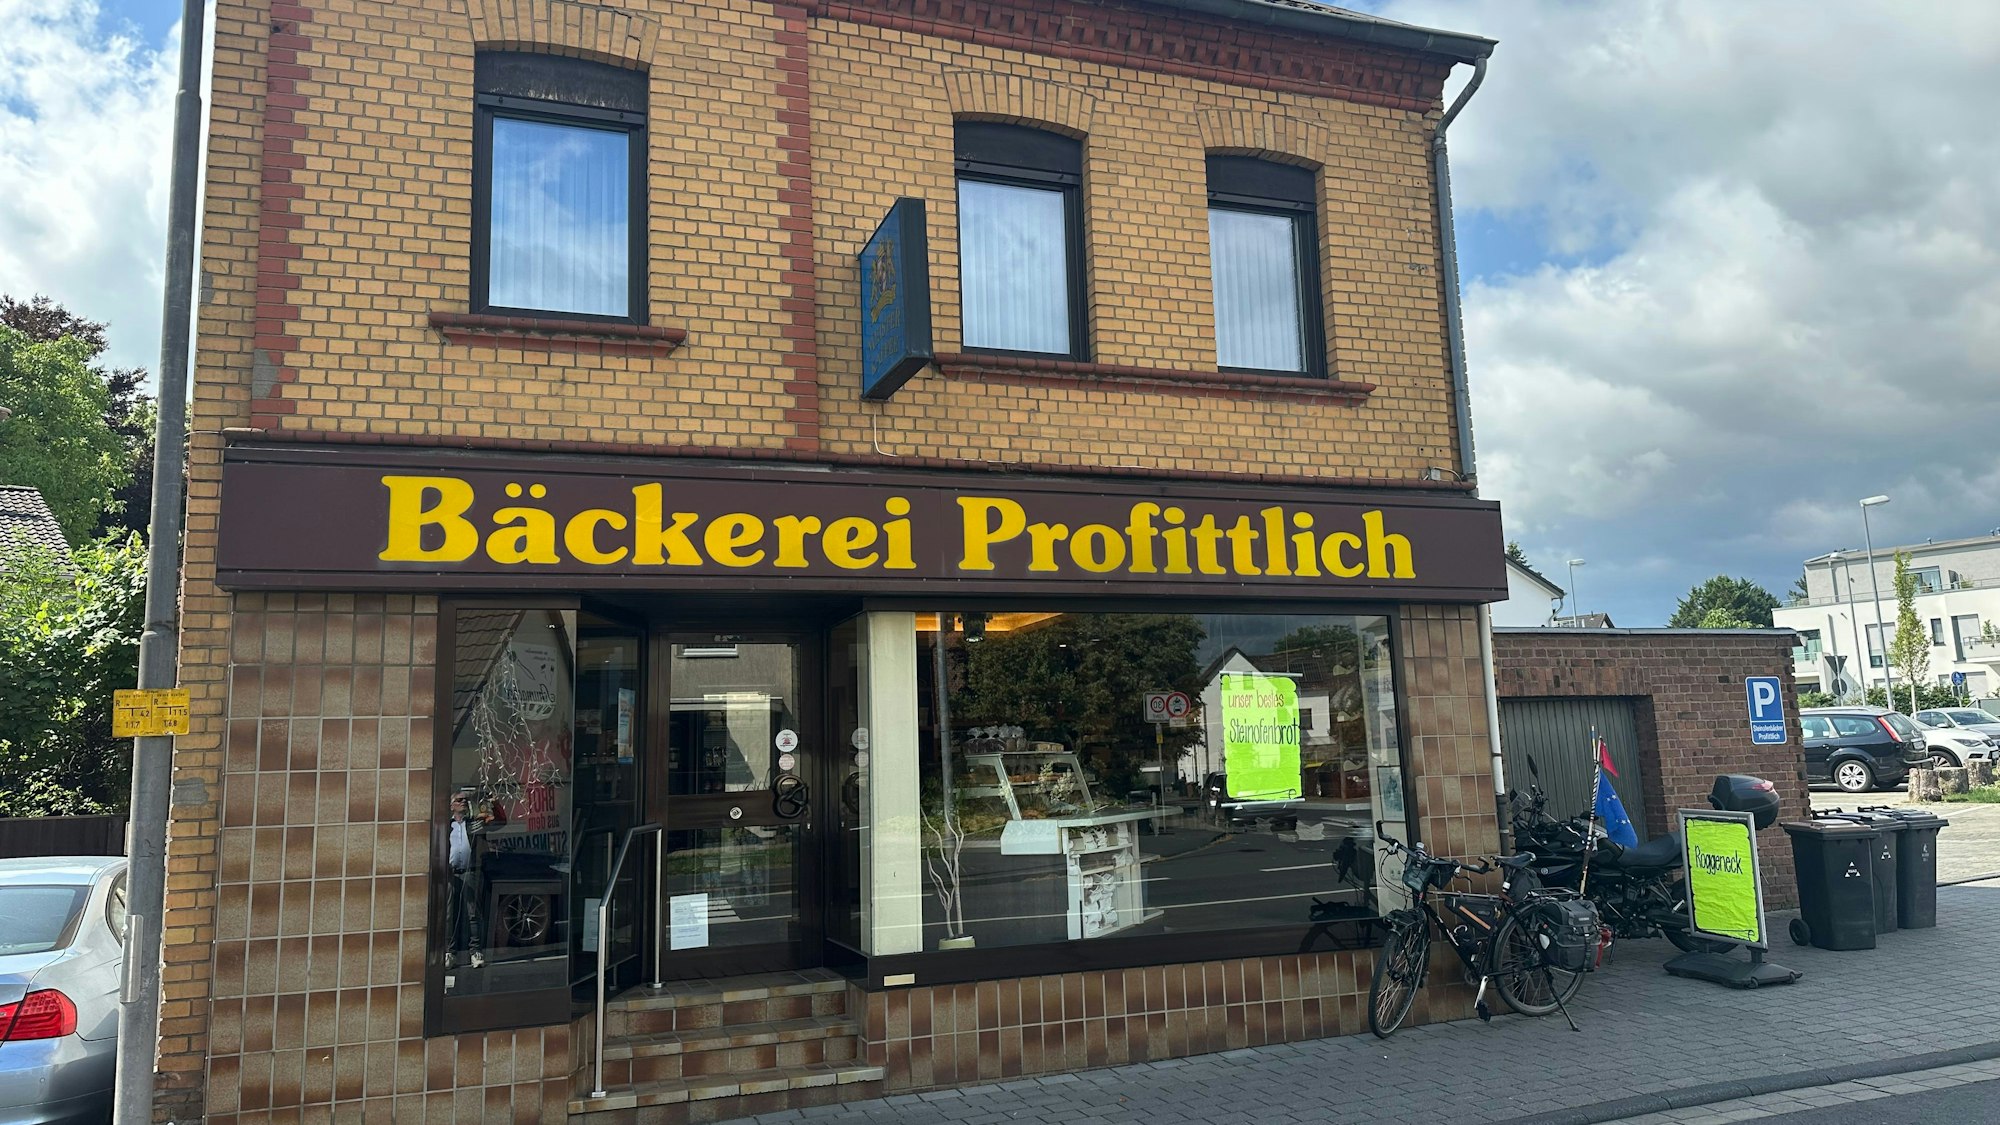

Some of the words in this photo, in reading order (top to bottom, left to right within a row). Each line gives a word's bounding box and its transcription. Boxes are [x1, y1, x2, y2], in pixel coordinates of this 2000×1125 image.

[378, 475, 917, 570] Bäckerei
[956, 496, 1416, 580] Profittlich
[153, 698, 159, 706] R
[1228, 693, 1254, 709] unser
[1256, 689, 1285, 709] bestes
[1752, 681, 1775, 718] P
[1229, 717, 1298, 746] Steinofenbrot
